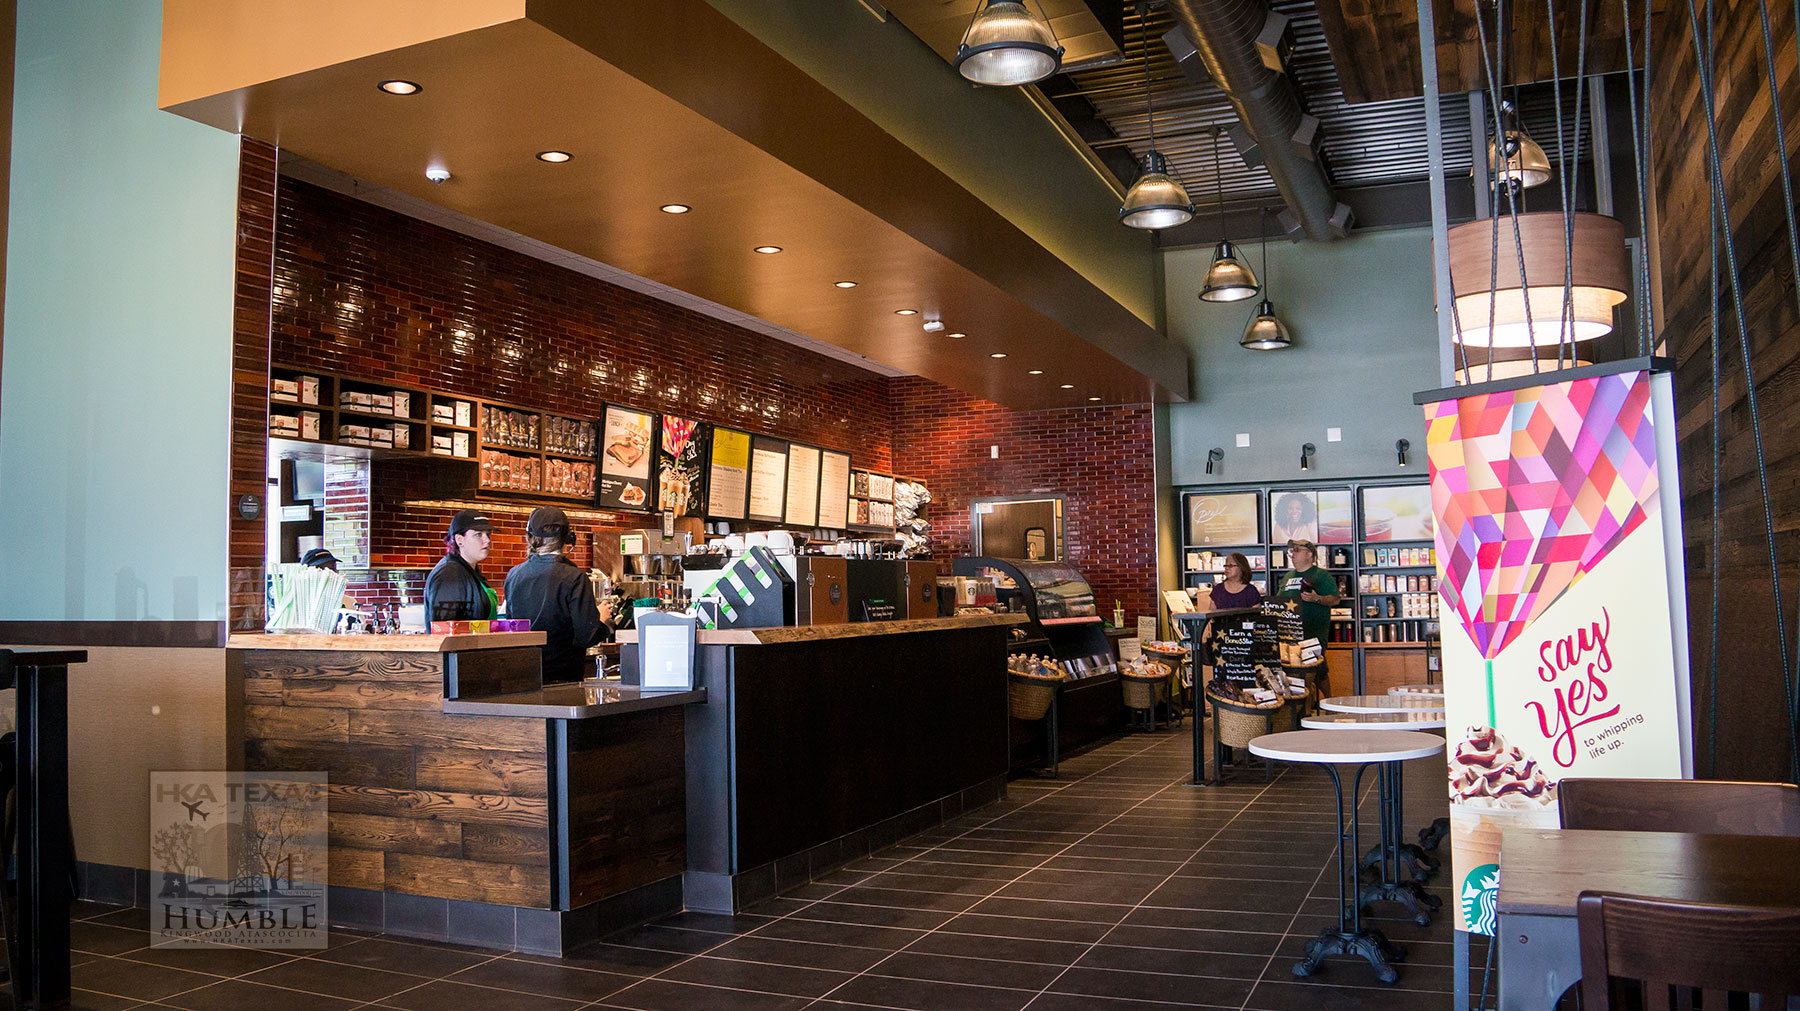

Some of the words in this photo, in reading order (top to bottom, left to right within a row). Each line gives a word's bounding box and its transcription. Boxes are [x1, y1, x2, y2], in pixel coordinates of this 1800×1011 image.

[1264, 601, 1280, 609] Earn
[1229, 629, 1246, 637] Earn
[1538, 606, 1612, 682] say
[1524, 663, 1620, 768] yes
[1584, 738, 1595, 747] to
[1597, 713, 1644, 741] whipping
[1589, 747, 1606, 759] life
[1607, 739, 1625, 750] up.
